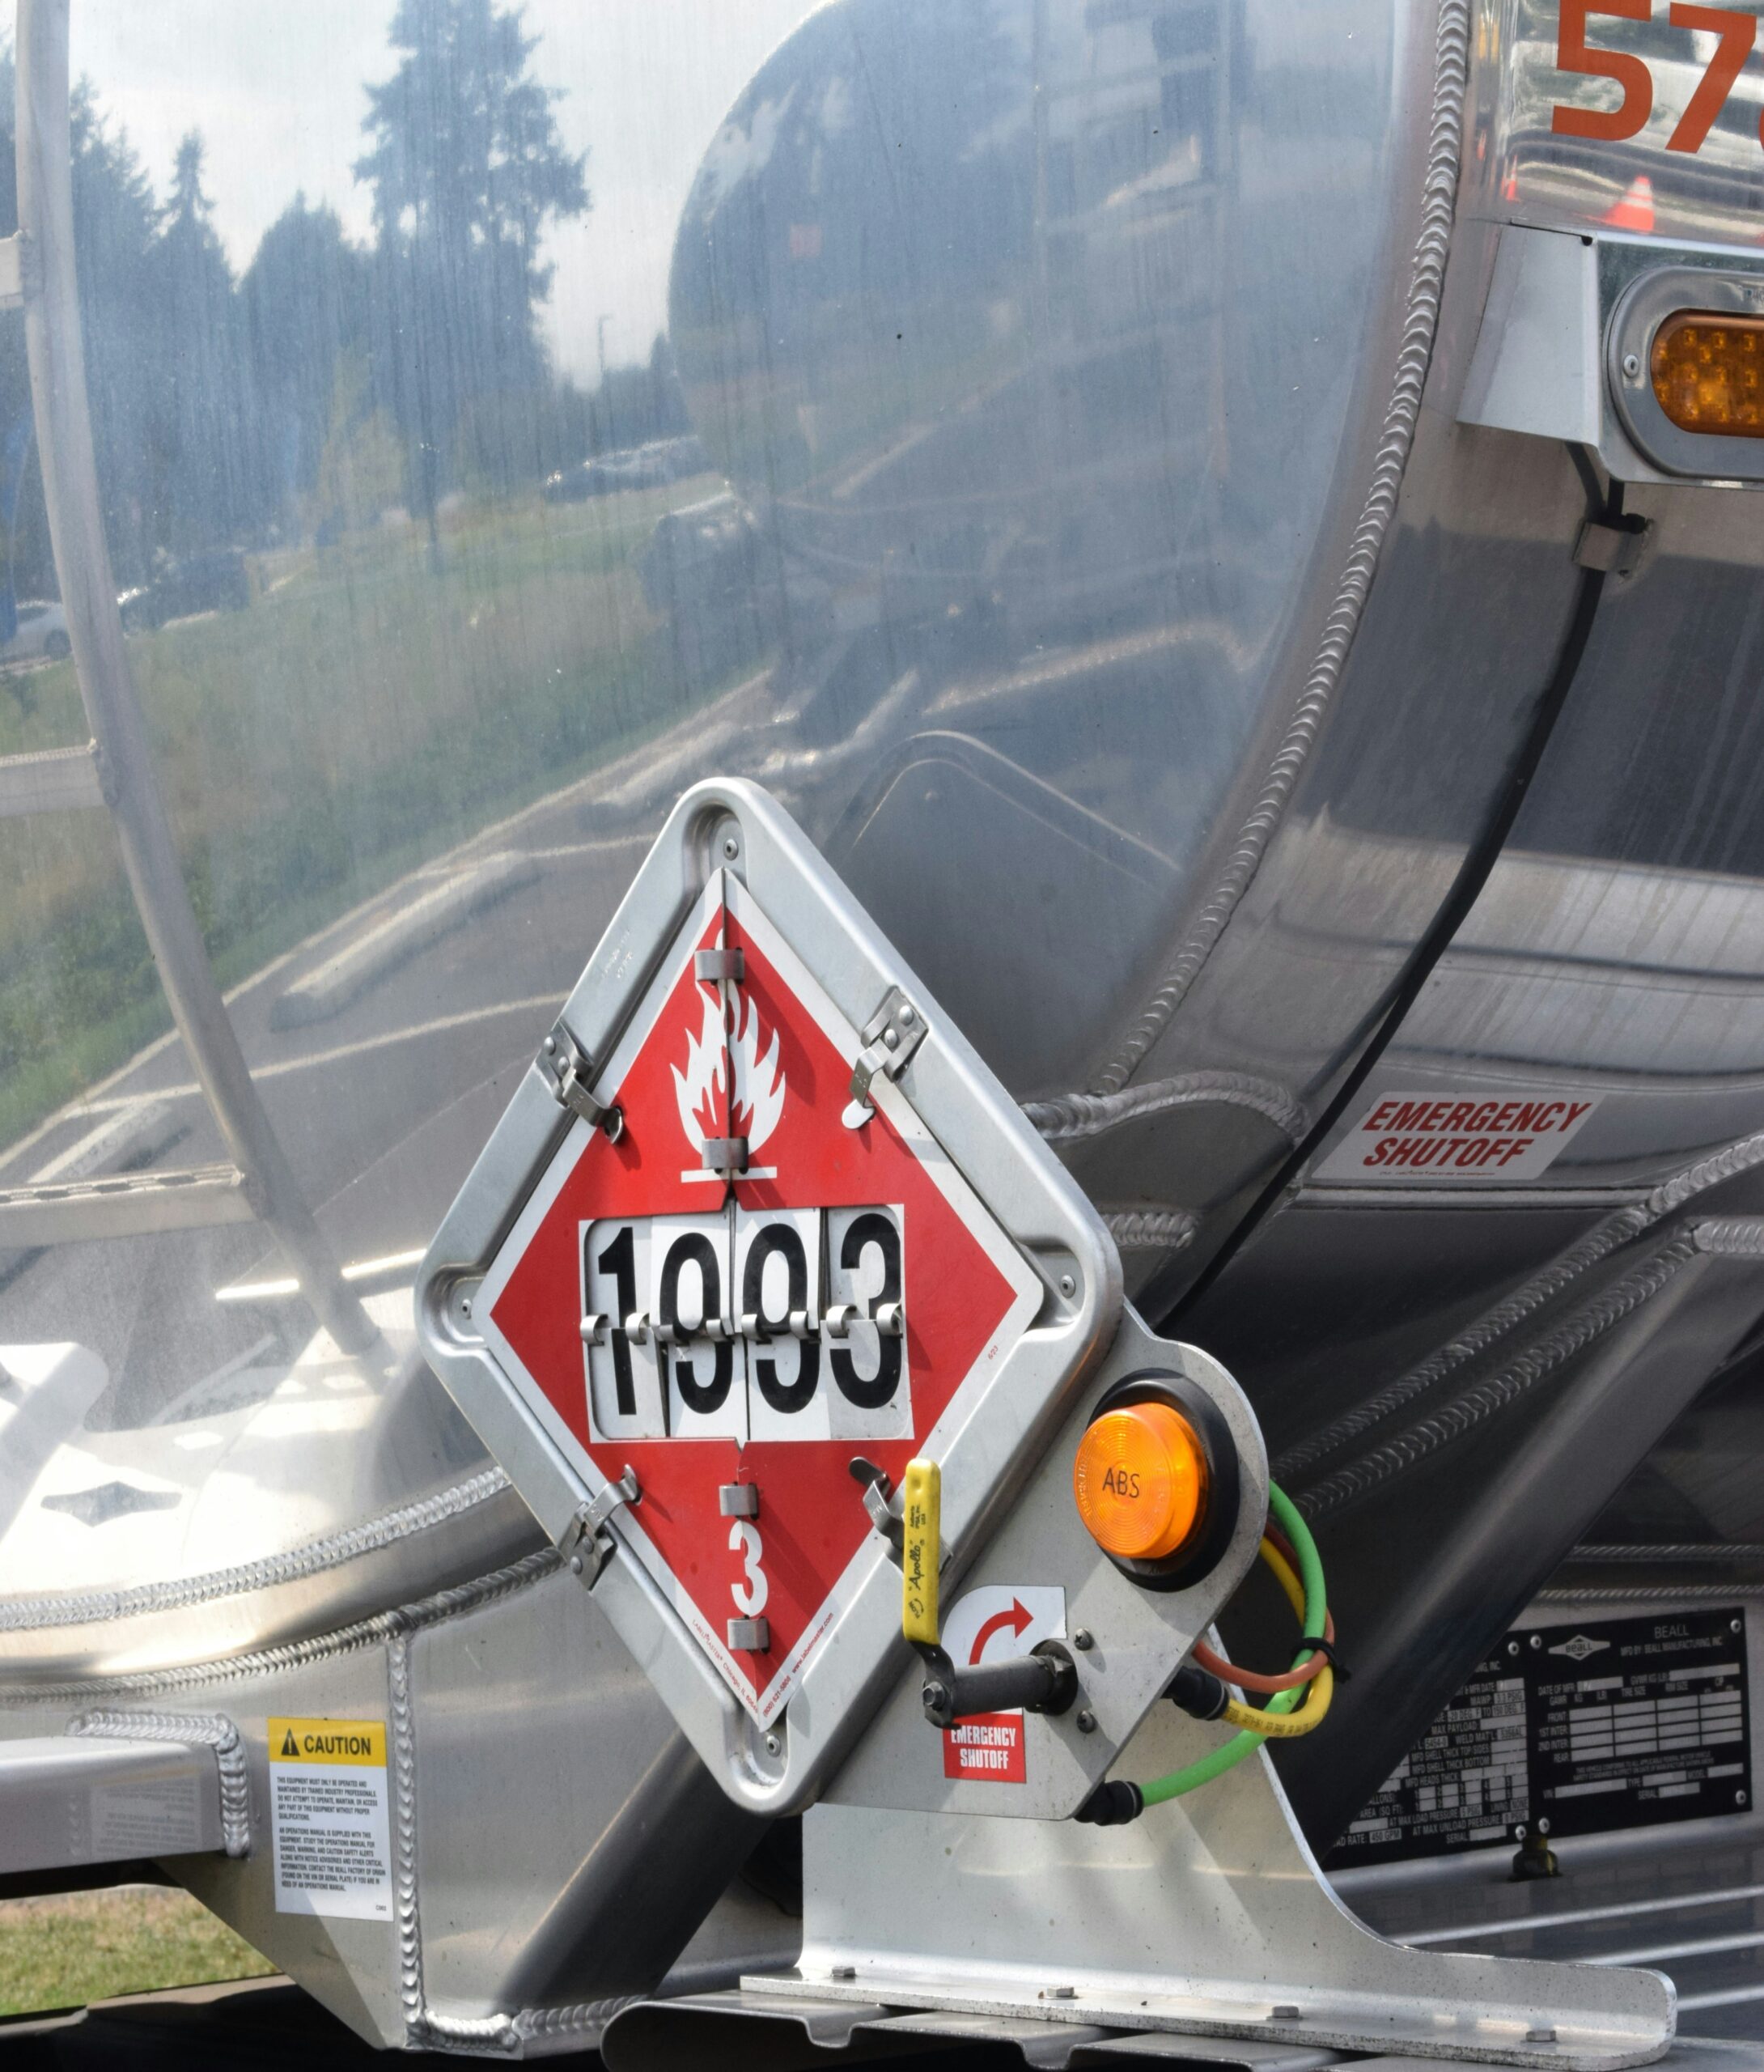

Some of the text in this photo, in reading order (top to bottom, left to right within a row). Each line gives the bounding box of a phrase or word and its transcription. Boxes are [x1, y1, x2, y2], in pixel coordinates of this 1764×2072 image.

[1551, 0, 1764, 154] 57
[1362, 1102, 1592, 1132] EMERGENCY
[1363, 1138, 1535, 1166] SHUTOFF
[597, 1213, 901, 1415] 1993
[1102, 1467, 1140, 1498] ABS
[729, 1520, 769, 1617] 3
[1654, 1624, 1690, 1639] BEALL
[1482, 1706, 1492, 1717] TO
[951, 1725, 1016, 1747] EMERGENCY
[1431, 1724, 1447, 1735] MAX
[1456, 1733, 1474, 1746] WELD
[304, 1734, 371, 1756] CAUTION
[960, 1747, 1009, 1769] SHUTOFF
[1360, 1807, 1376, 1819] AREA
[1389, 1817, 1397, 1828] AT
[1397, 1815, 1411, 1827] MAX
[1412, 1812, 1428, 1824] LOAD
[1413, 1826, 1422, 1836] AT
[1423, 1824, 1438, 1836] MAX
[1439, 1820, 1467, 1833] UNLOAD
